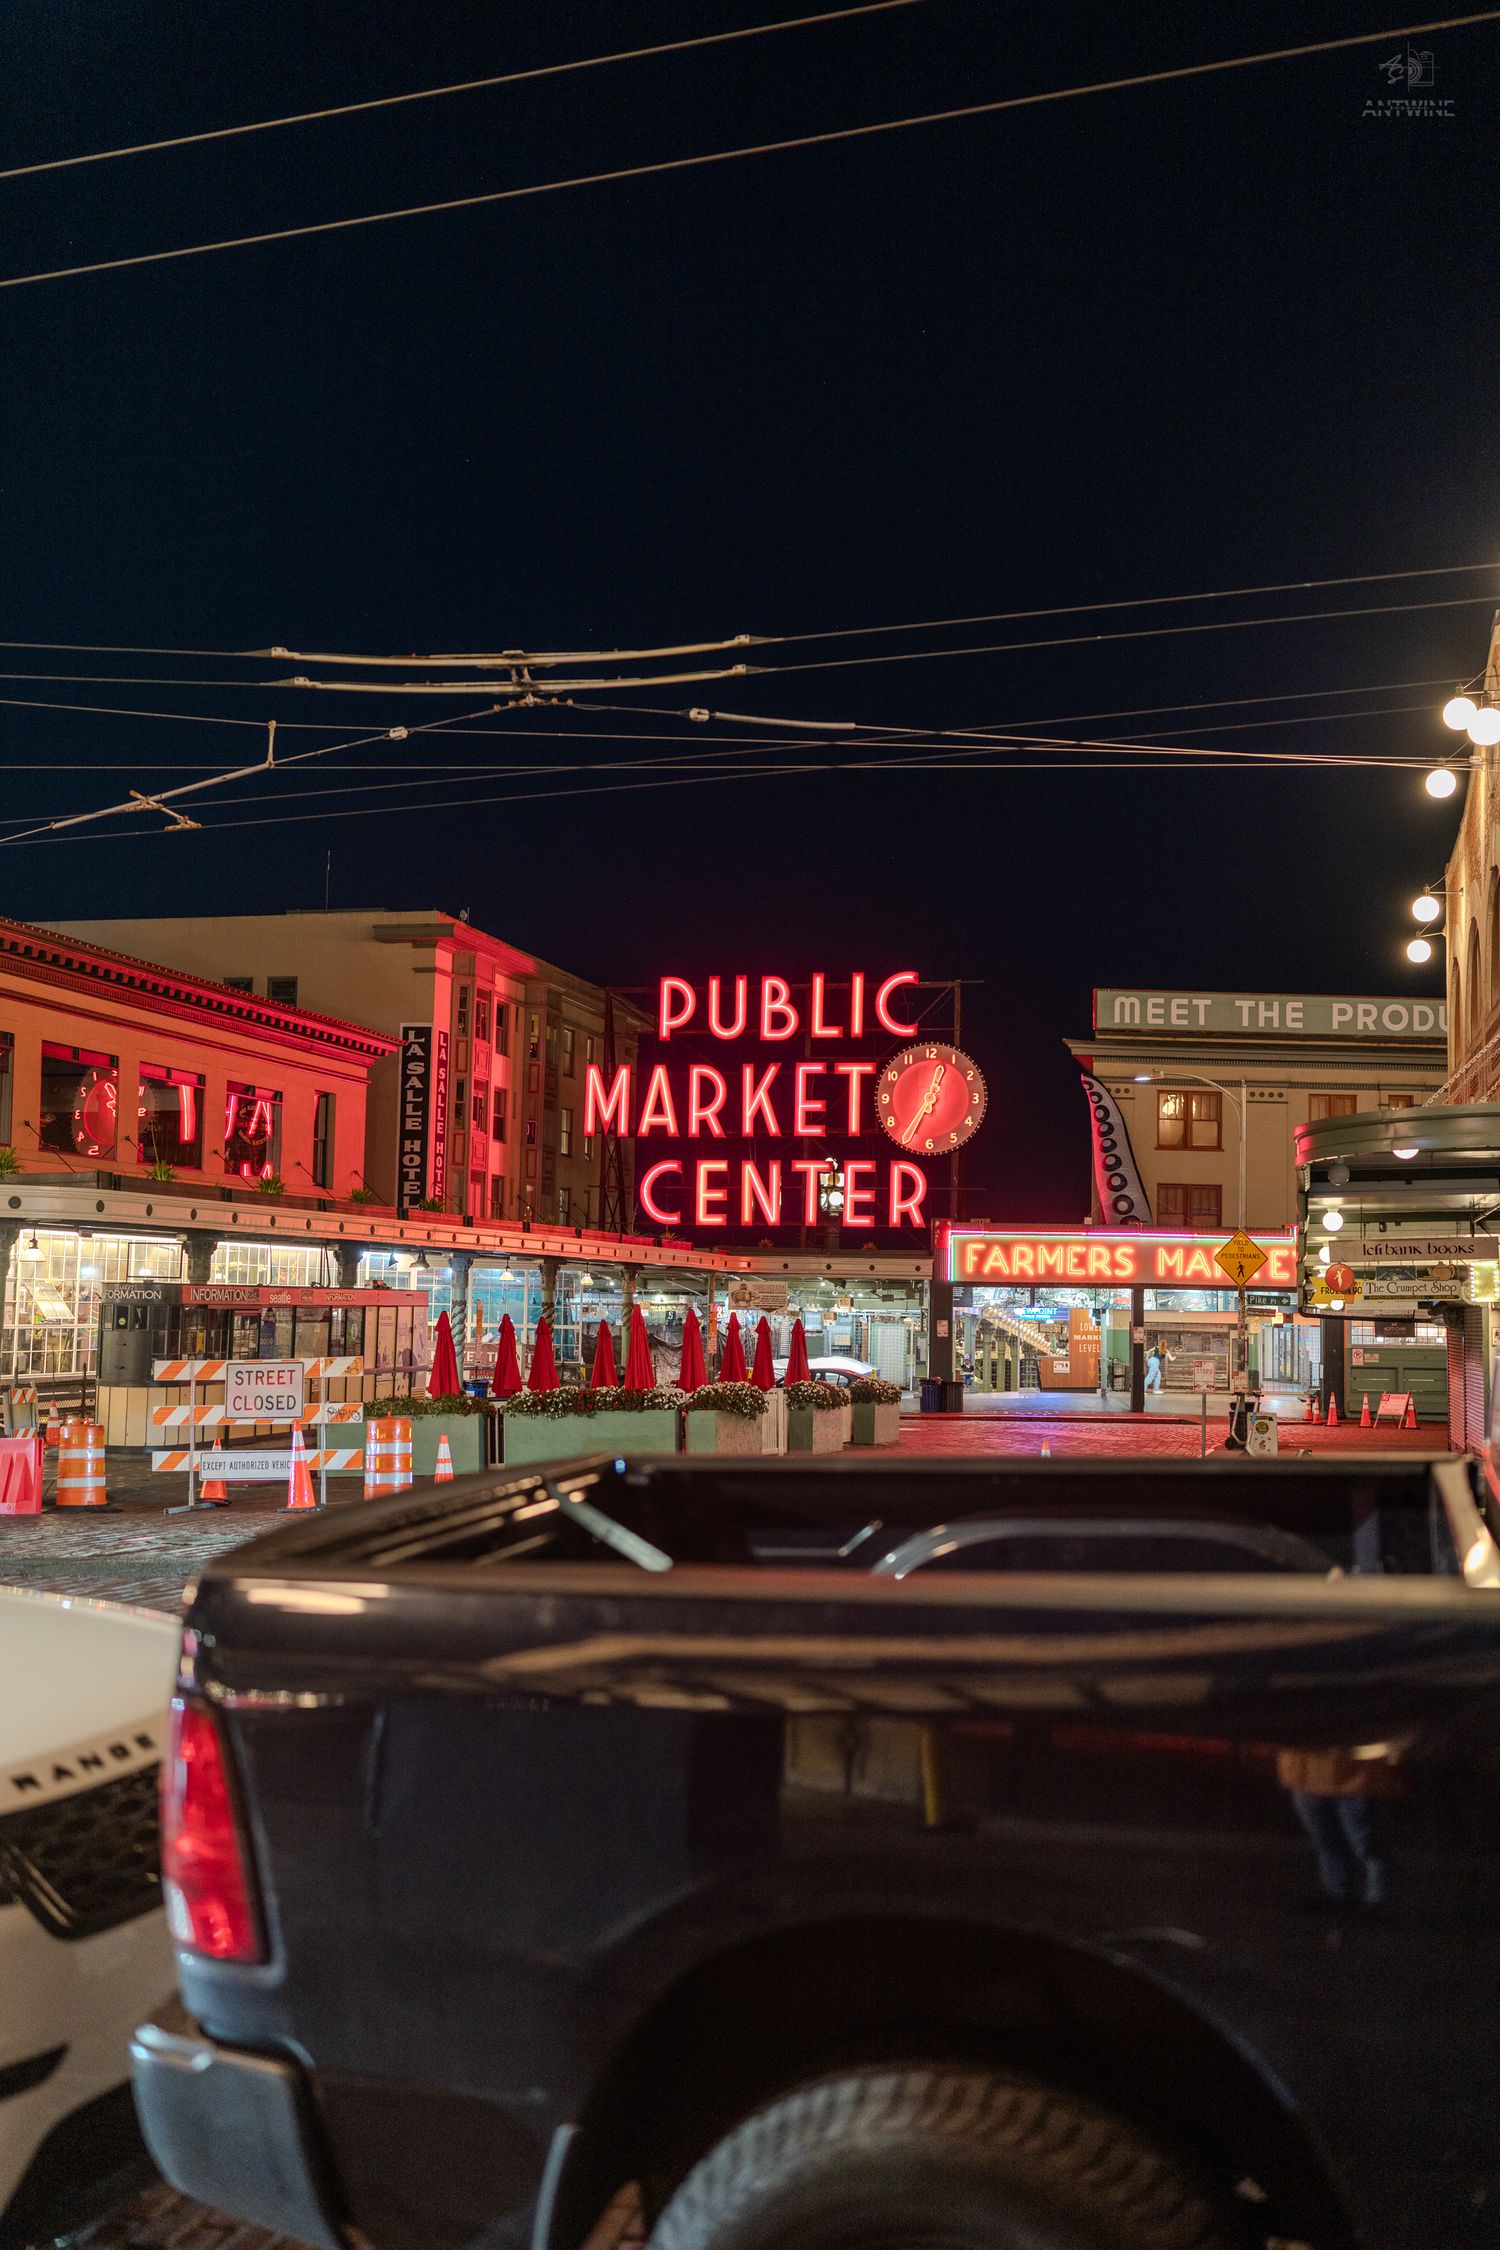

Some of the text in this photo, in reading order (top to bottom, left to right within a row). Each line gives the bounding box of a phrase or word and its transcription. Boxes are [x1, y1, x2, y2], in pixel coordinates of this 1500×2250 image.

[659, 971, 919, 1041] PUBLIC
[1113, 996, 1212, 1026] MEET
[1235, 1000, 1304, 1028] THE
[904, 1054, 913, 1065] 11
[926, 1048, 937, 1059] 12
[887, 1071, 898, 1081] 10
[966, 1070, 974, 1081] 2
[584, 1062, 876, 1138] MARKET
[881, 1094, 890, 1104] 9
[972, 1093, 980, 1104] 3
[402, 1030, 425, 1209] LA SALLE HOTEL
[434, 1033, 447, 1200] LA SALLE HOTE
[887, 1116, 895, 1127] 8
[964, 1116, 973, 1127] 4
[925, 1139, 934, 1149] 6
[950, 1133, 957, 1143] 5
[639, 1159, 928, 1228] CENTER
[1385, 1243, 1422, 1256] bank
[1428, 1242, 1475, 1255] books
[963, 1243, 1296, 1280] FARMERS MAE
[190, 1287, 247, 1302] INFORMATION
[1366, 1282, 1385, 1294] The
[1386, 1282, 1427, 1296] Crumpet
[1430, 1282, 1457, 1296] Shop
[269, 1290, 292, 1304] seattle
[1249, 1295, 1267, 1304] Pike
[1079, 1343, 1101, 1353] LEVEL
[235, 1370, 296, 1386] STREET
[232, 1394, 297, 1411] CLOSED
[202, 1460, 291, 1471] EXCEPT AUTHORIZED VEHIC
[11, 1731, 156, 1793] RANGE
